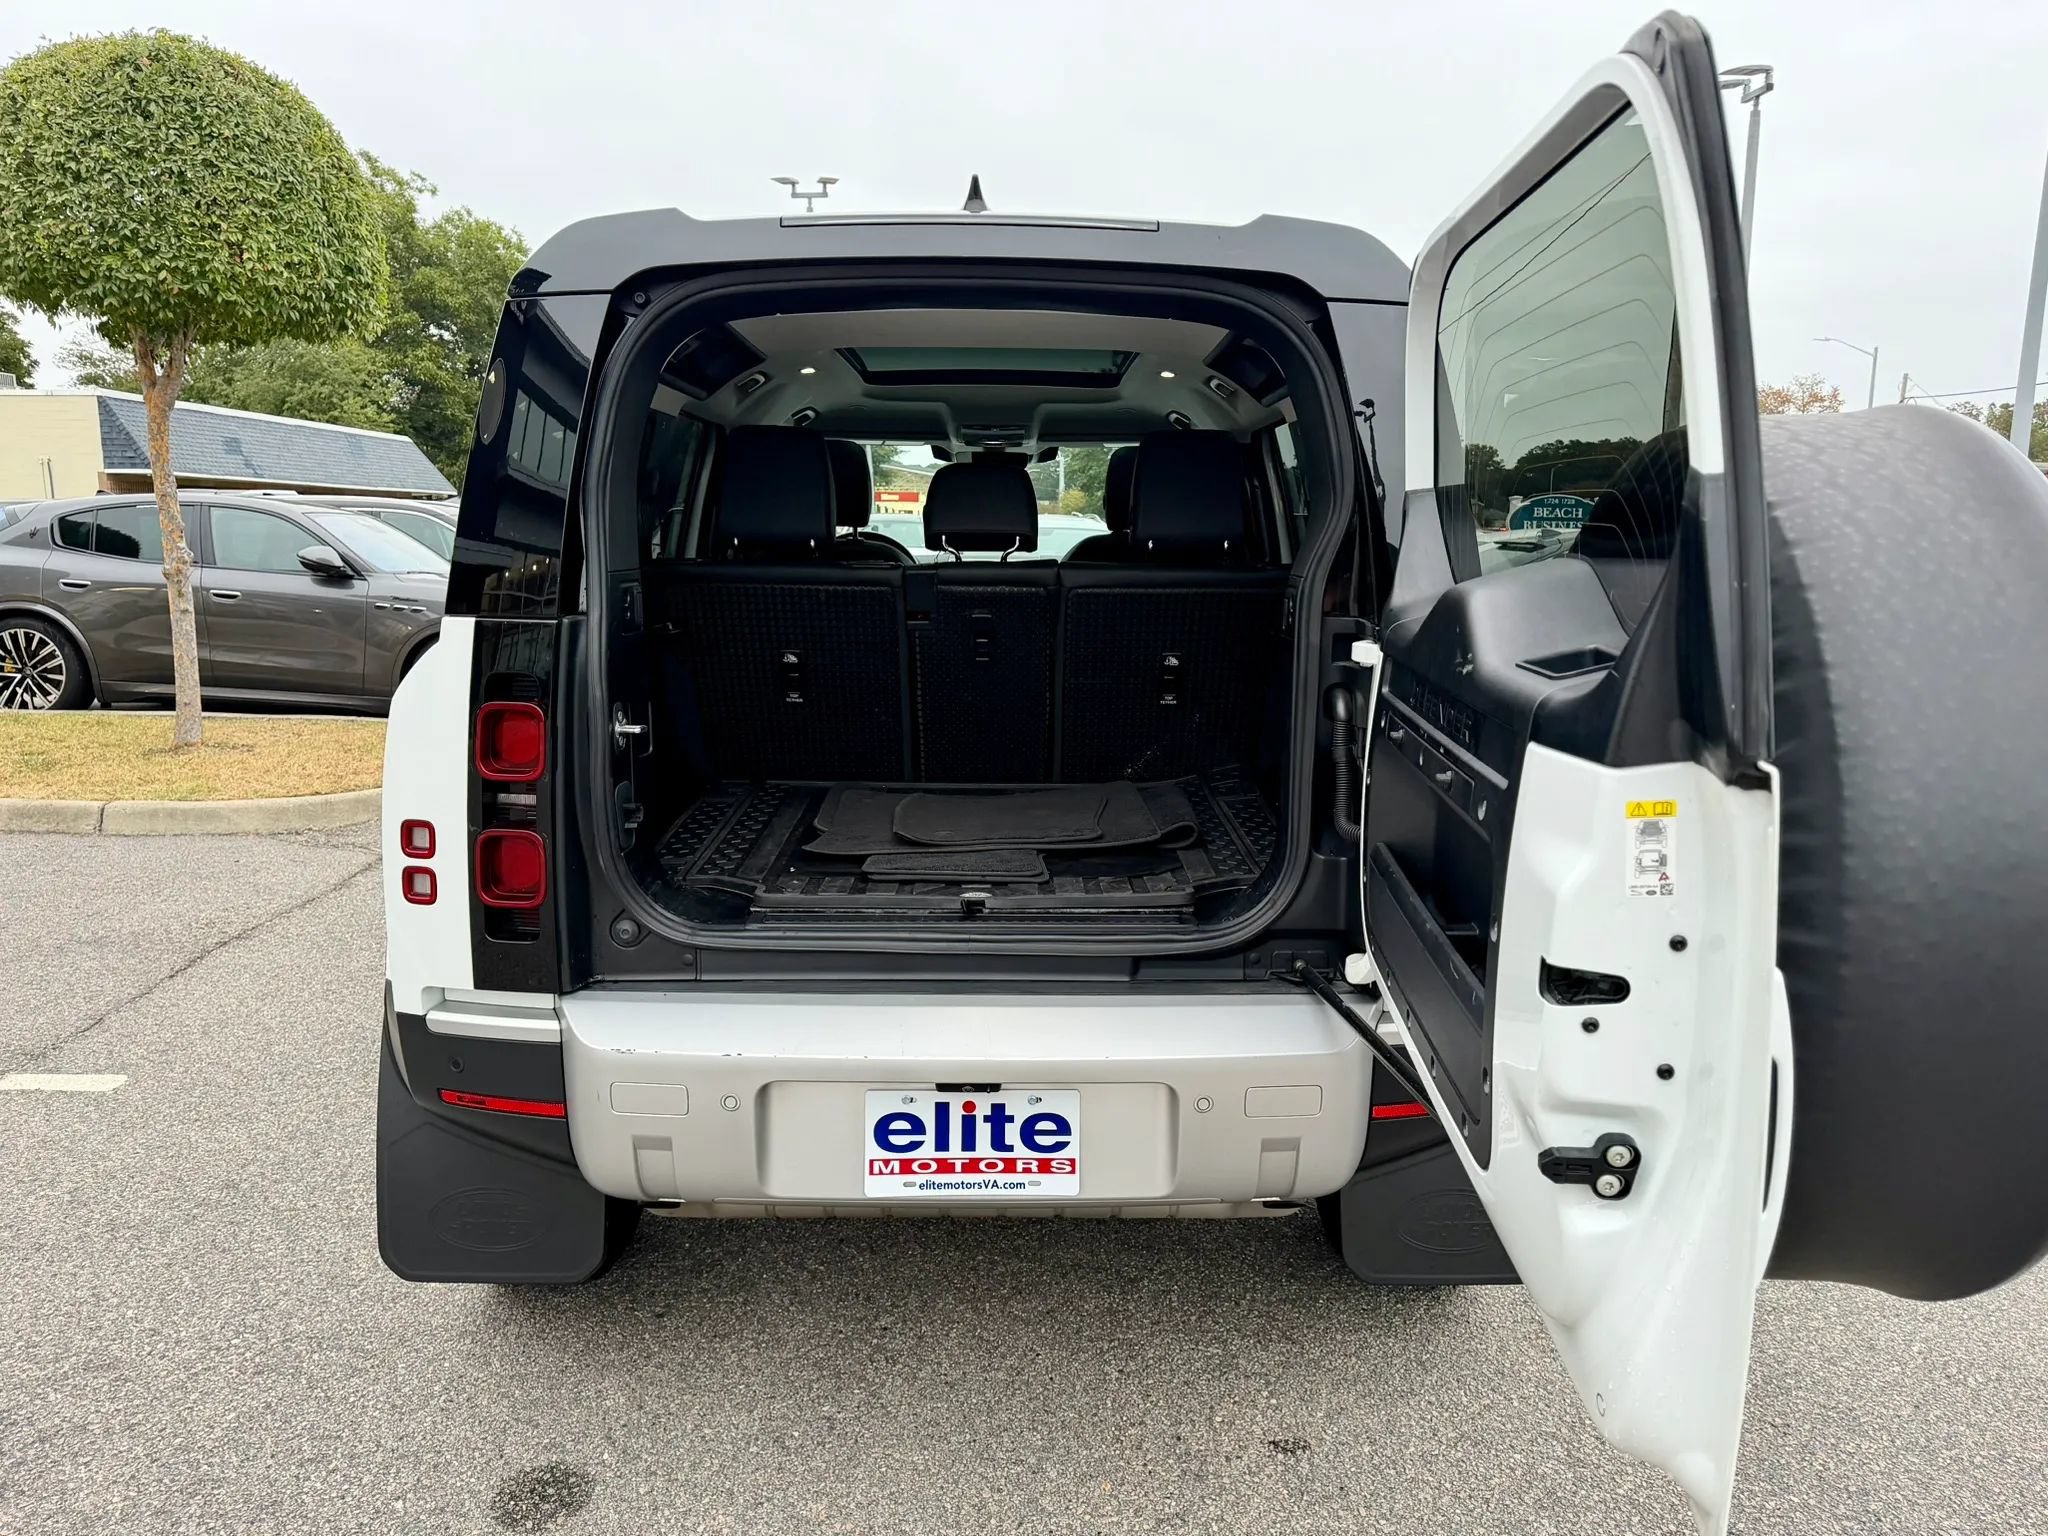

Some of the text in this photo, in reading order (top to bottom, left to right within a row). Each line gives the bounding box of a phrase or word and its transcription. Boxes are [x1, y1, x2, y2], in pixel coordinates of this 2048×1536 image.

[1533, 507, 1583, 518] BEACH
[1523, 520, 1584, 529] BUSINES
[873, 1099, 1073, 1154] elite
[872, 1158, 1073, 1174] MOTORS
[918, 1178, 1026, 1190] elitemotorsVA.com
